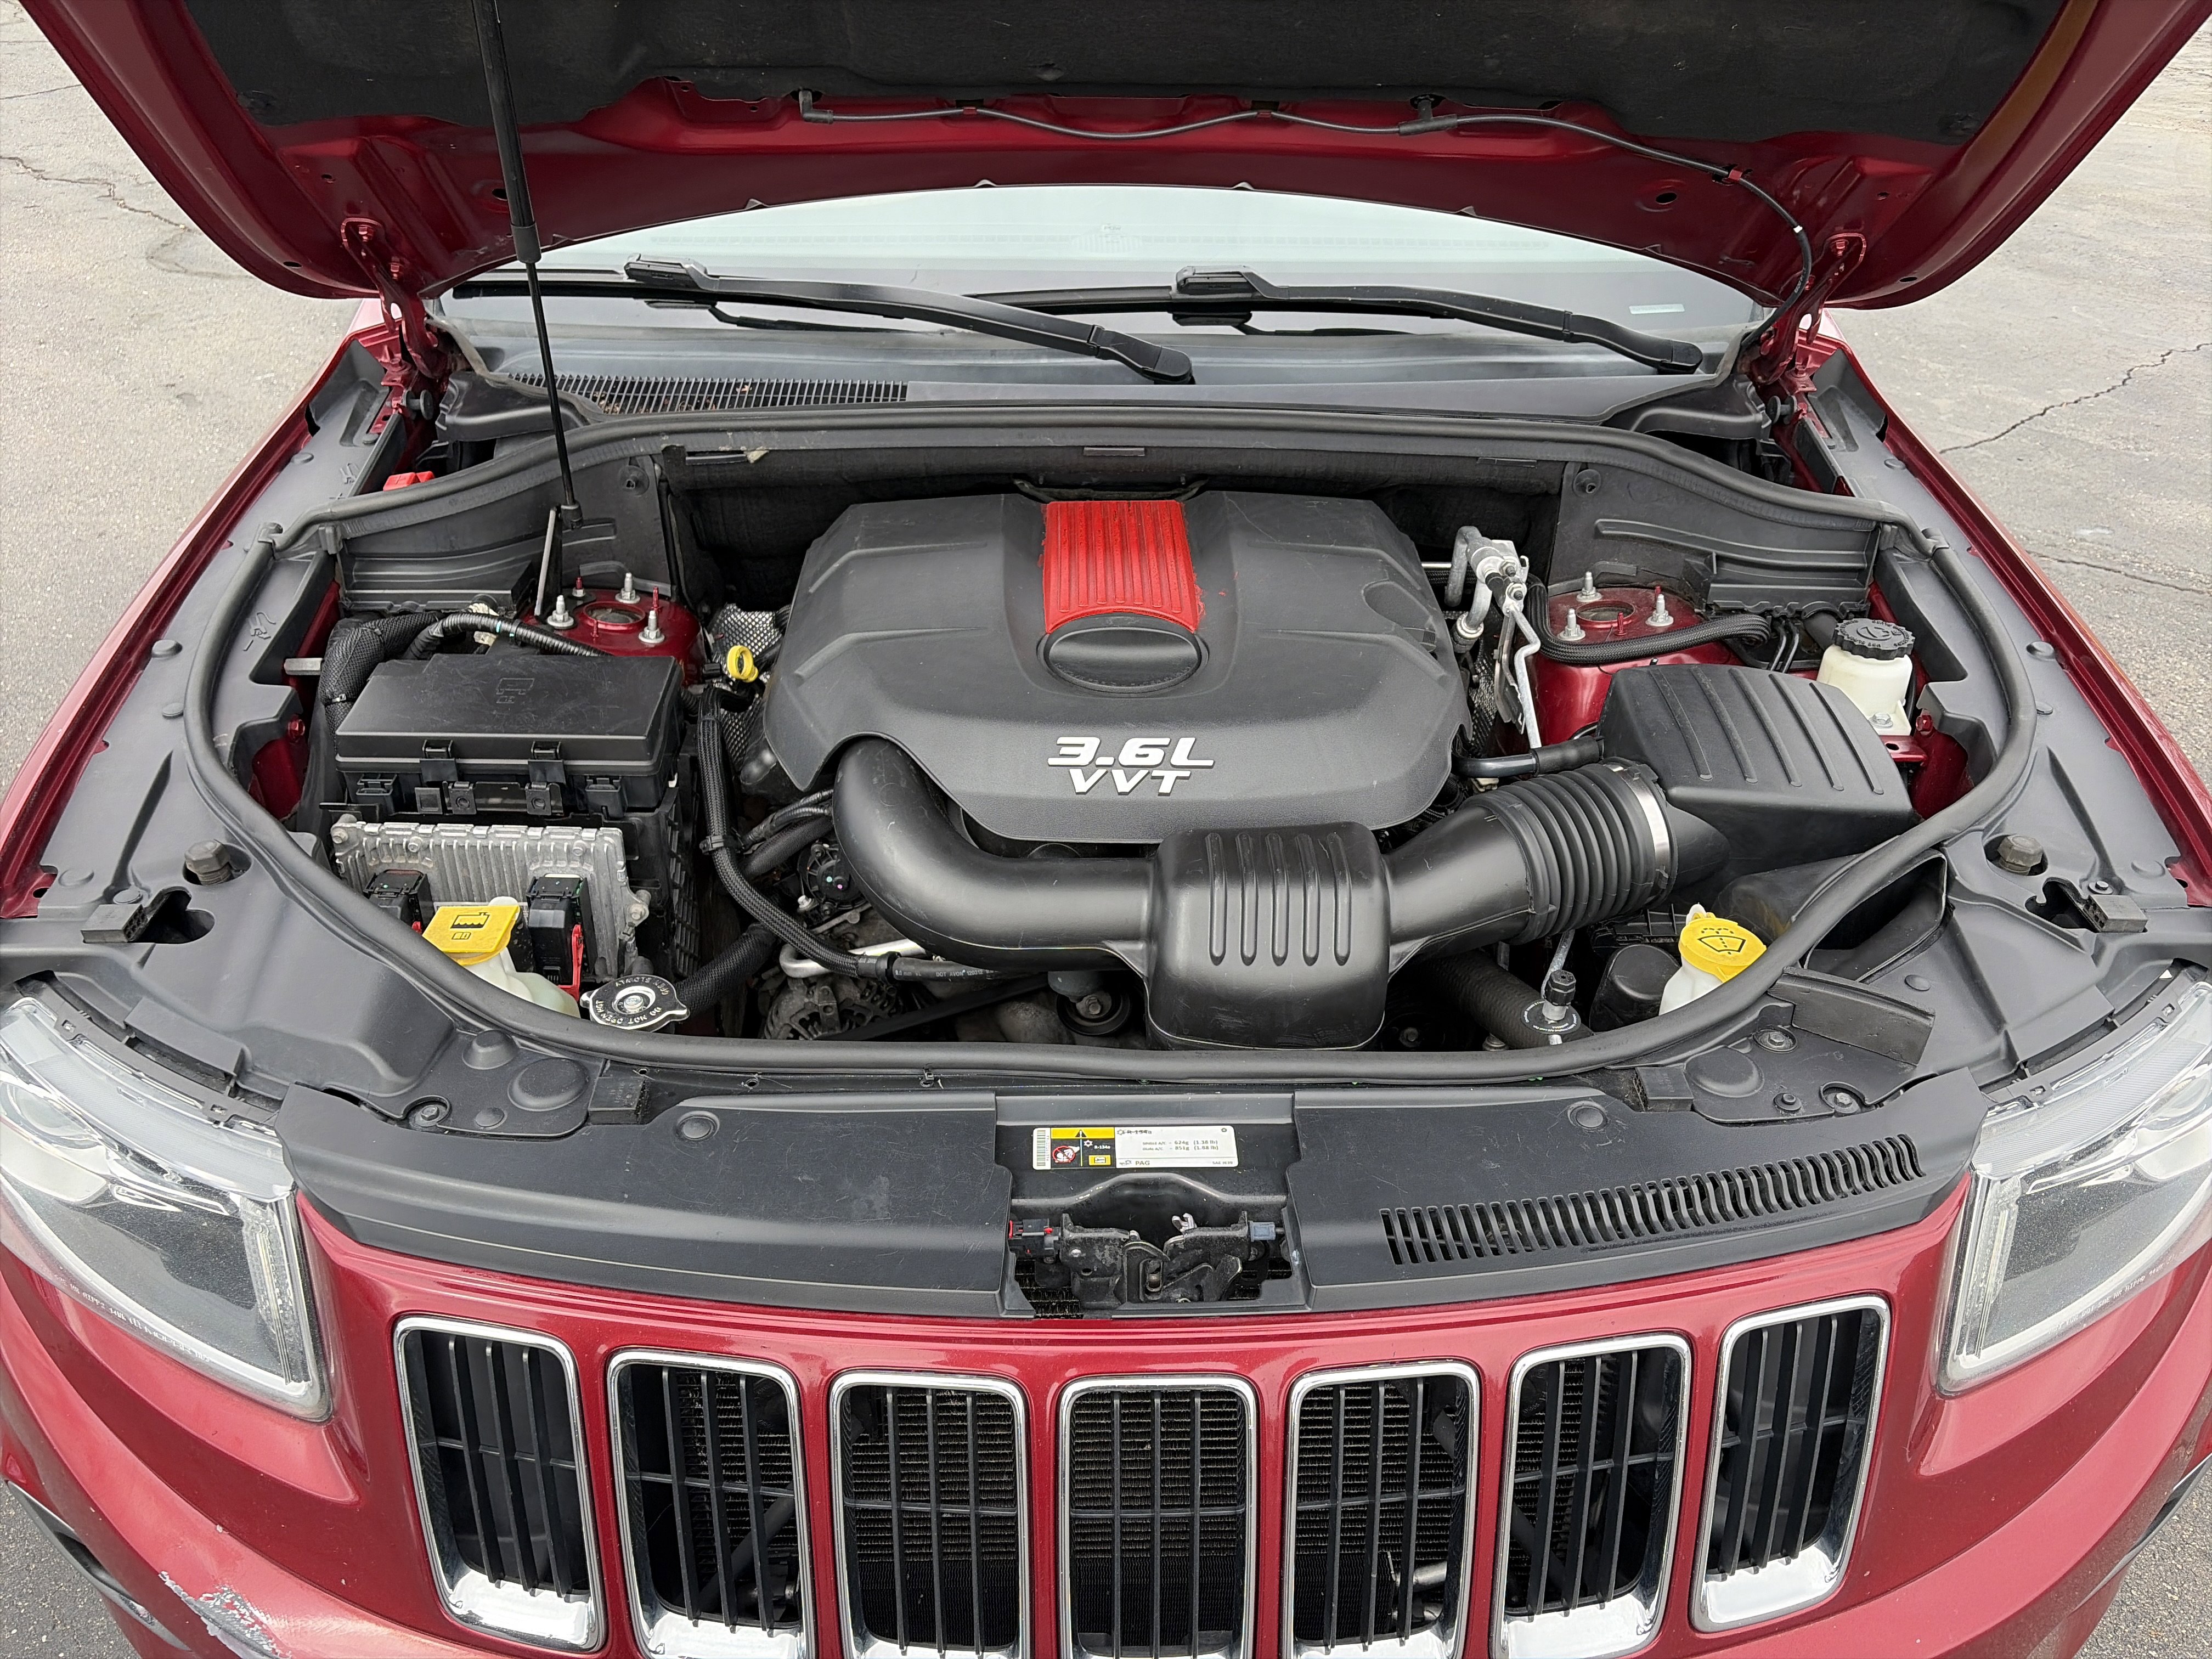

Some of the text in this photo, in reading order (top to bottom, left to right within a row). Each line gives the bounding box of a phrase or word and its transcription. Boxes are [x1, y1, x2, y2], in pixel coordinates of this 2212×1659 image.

[1047, 737, 1215, 768] 3.6L
[1069, 769, 1191, 796] VVT
[616, 977, 651, 987] SLOWLY
[650, 1007, 662, 1016] DO
[601, 1013, 623, 1024] OPEN
[628, 1015, 647, 1024] NOT
